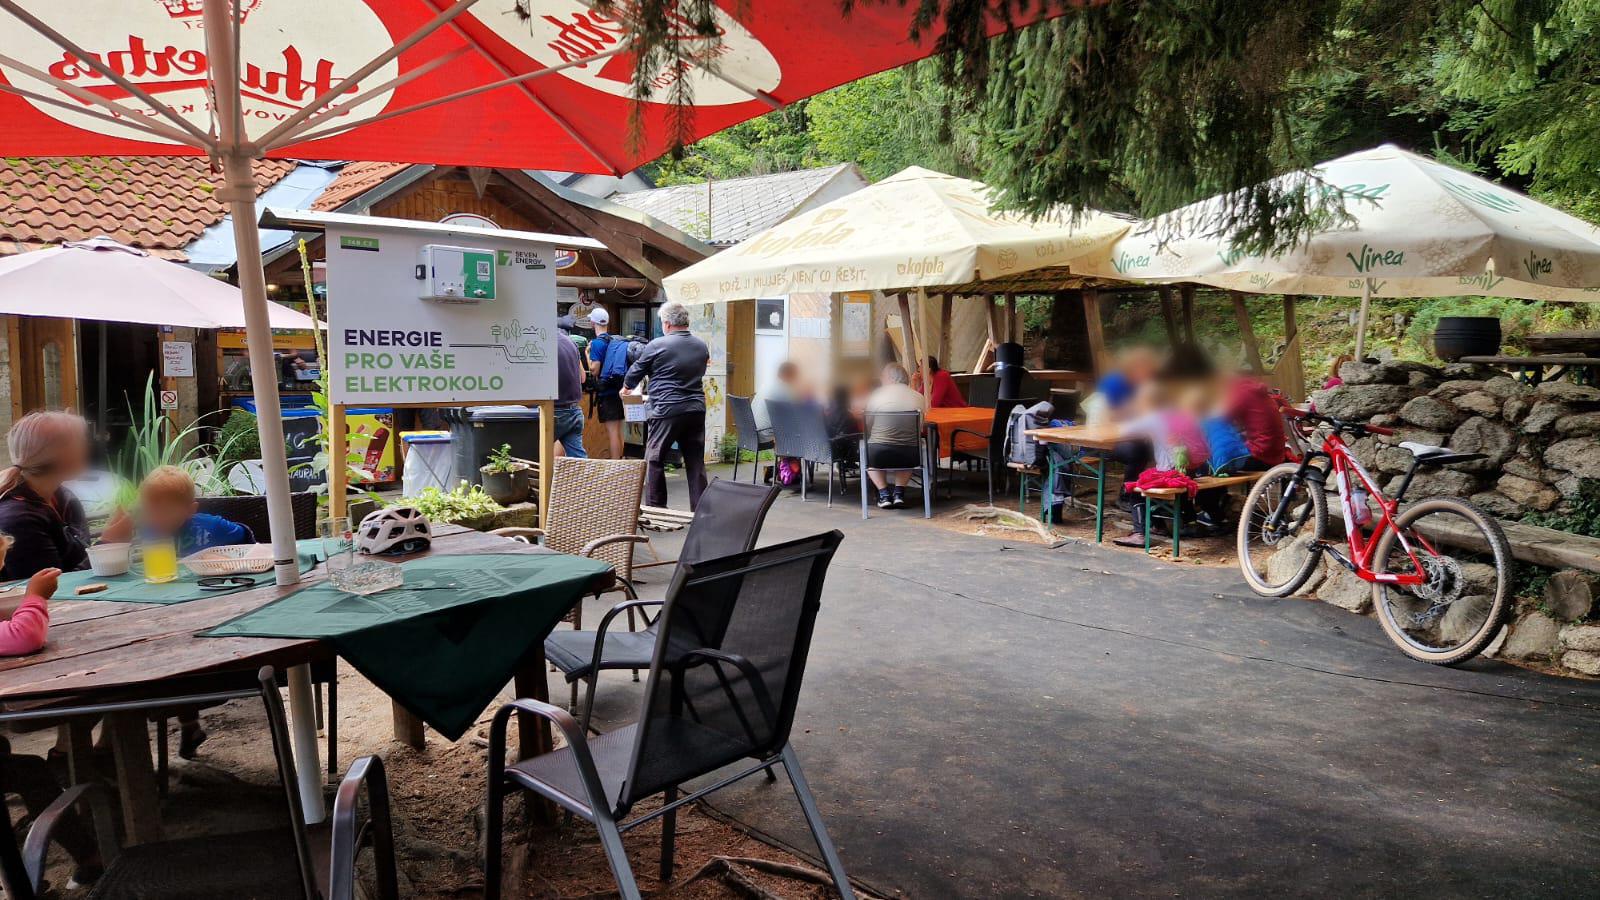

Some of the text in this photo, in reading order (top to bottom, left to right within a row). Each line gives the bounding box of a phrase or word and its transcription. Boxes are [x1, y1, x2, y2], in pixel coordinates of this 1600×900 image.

[515, 251, 538, 259] SEVEN
[515, 257, 543, 265] ENERGY
[1110, 251, 1151, 273] Vinea
[1346, 244, 1405, 274] Vinea
[906, 256, 945, 279] kofola
[1523, 250, 1553, 281] Vinea
[820, 270, 832, 282] CO
[344, 329, 442, 347] ENERGIE
[345, 350, 456, 370] PRO VAŠE
[345, 375, 503, 393] ELEKTROKOLO
